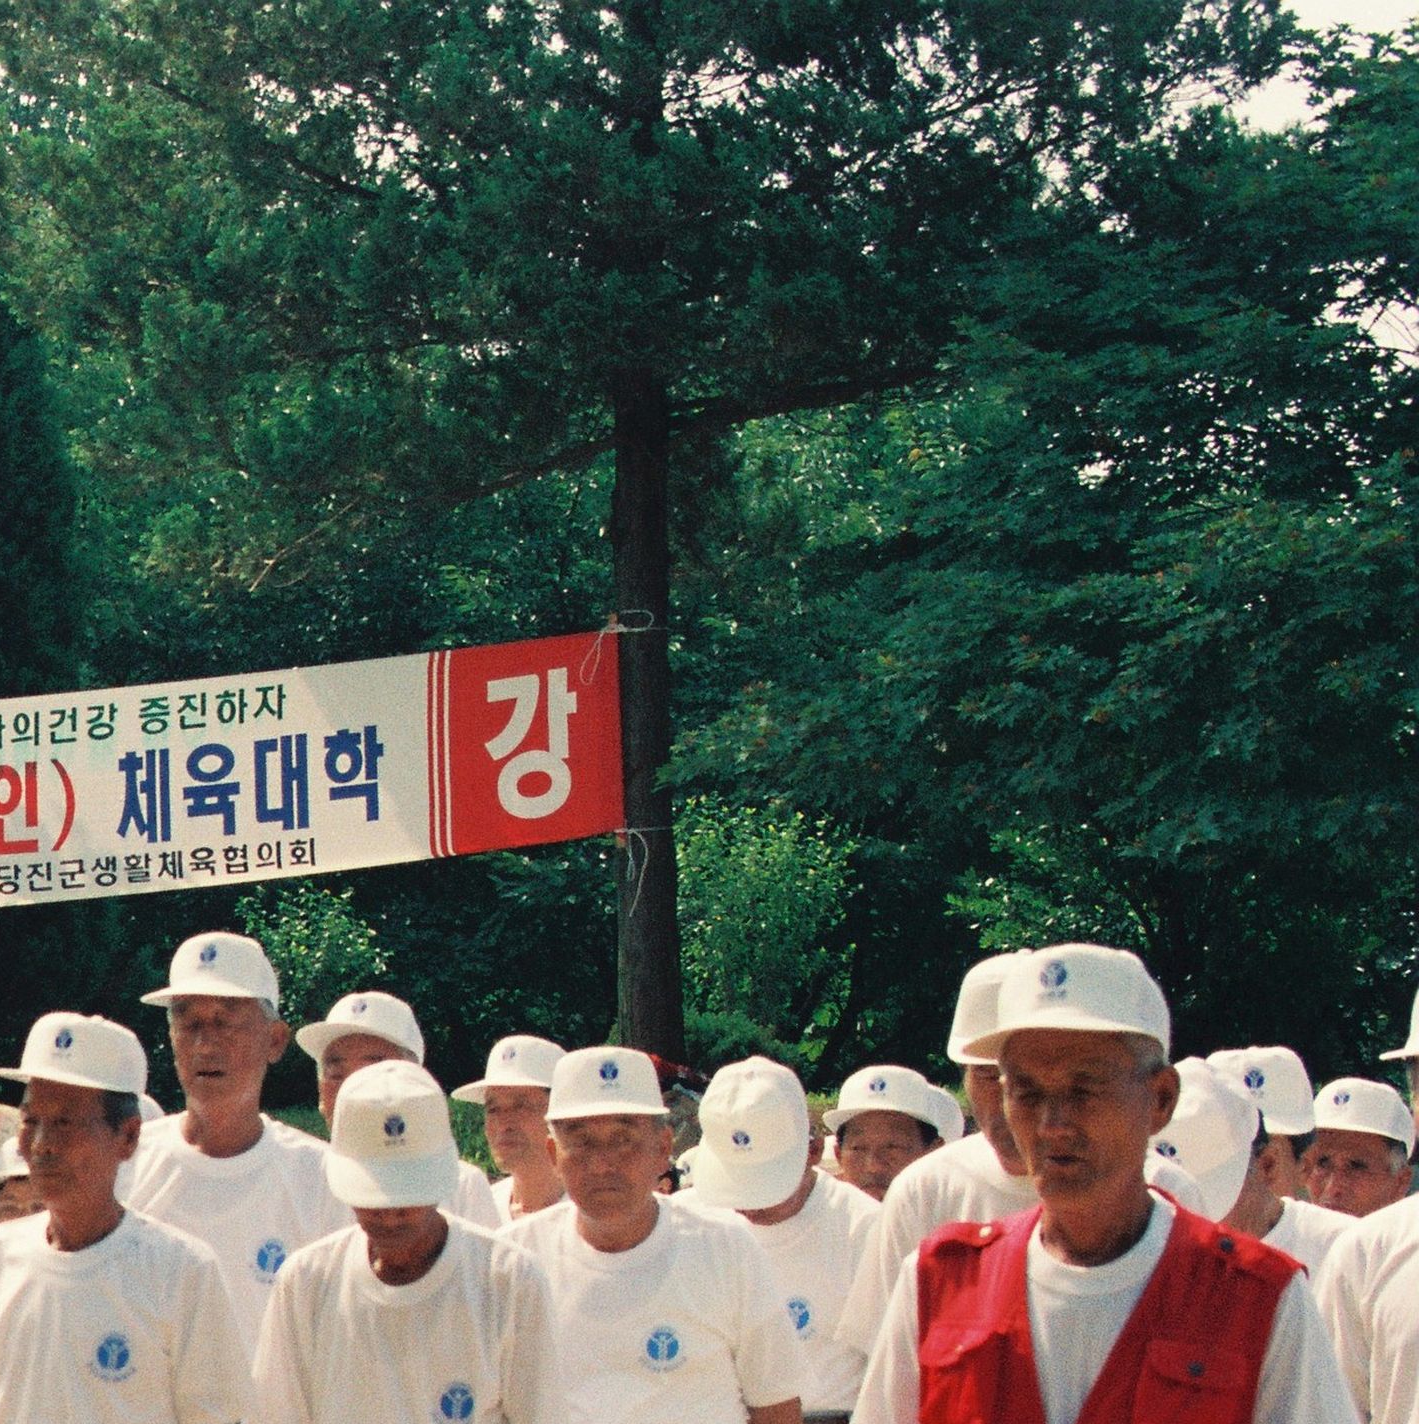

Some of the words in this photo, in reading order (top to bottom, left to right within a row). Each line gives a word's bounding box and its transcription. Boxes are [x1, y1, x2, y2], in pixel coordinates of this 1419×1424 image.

[139, 684, 287, 735] 증진하자
[484, 666, 577, 820] 강
[116, 724, 385, 844] 체육대학
